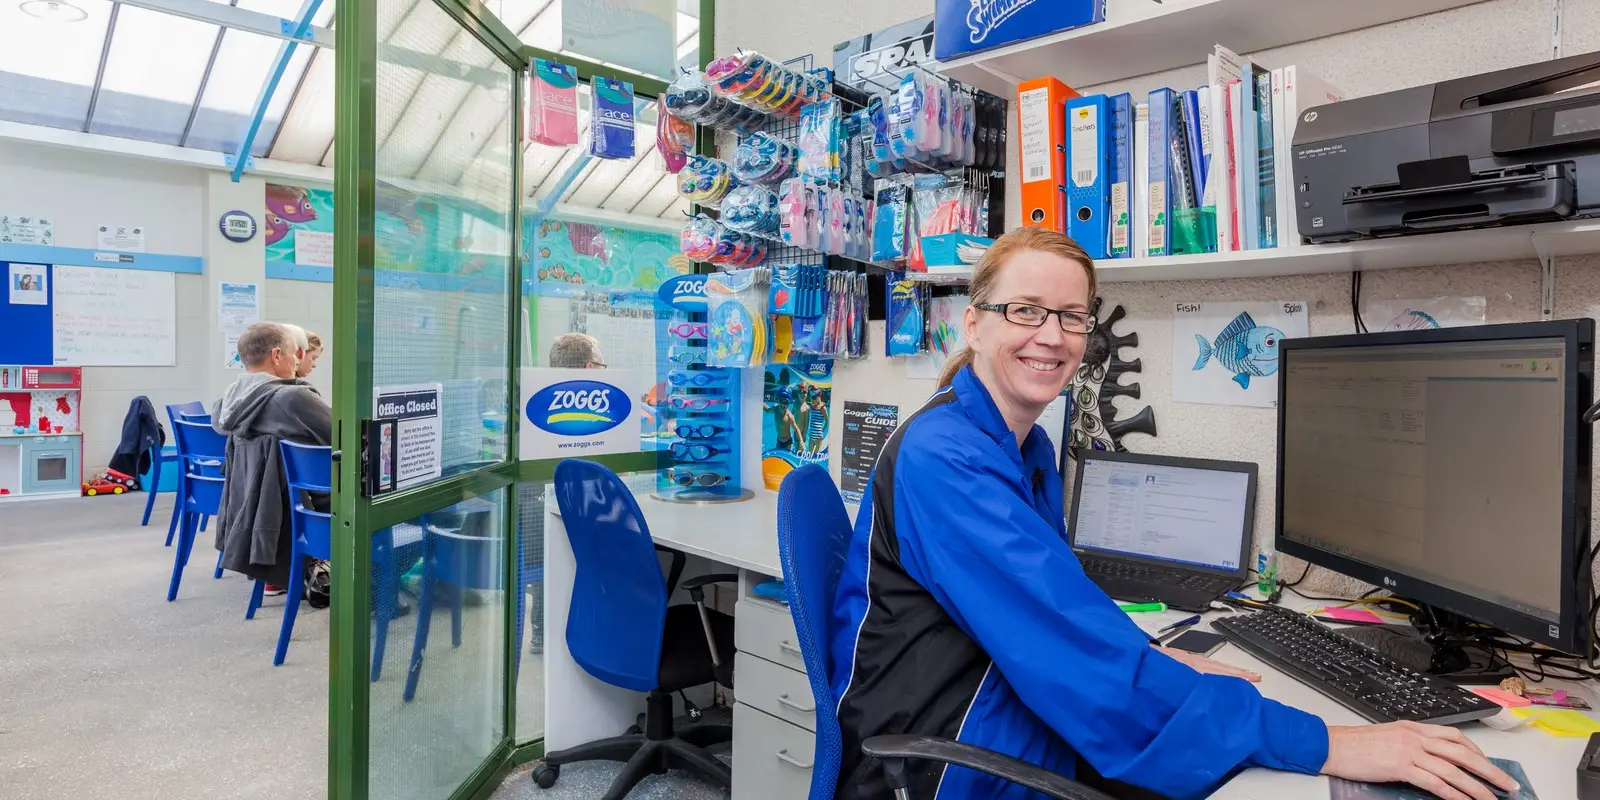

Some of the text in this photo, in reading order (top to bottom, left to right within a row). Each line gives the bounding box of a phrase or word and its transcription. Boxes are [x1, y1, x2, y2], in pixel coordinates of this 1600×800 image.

[673, 280, 708, 297] ZOG
[1176, 303, 1201, 313] Fish!
[809, 363, 827, 372] ZOGGS
[548, 388, 611, 413] ZOGGS
[378, 398, 437, 417] Office Closed
[844, 408, 875, 419] Goggle
[864, 416, 897, 427] GUIDE
[558, 440, 605, 449] www.zoggs.com
